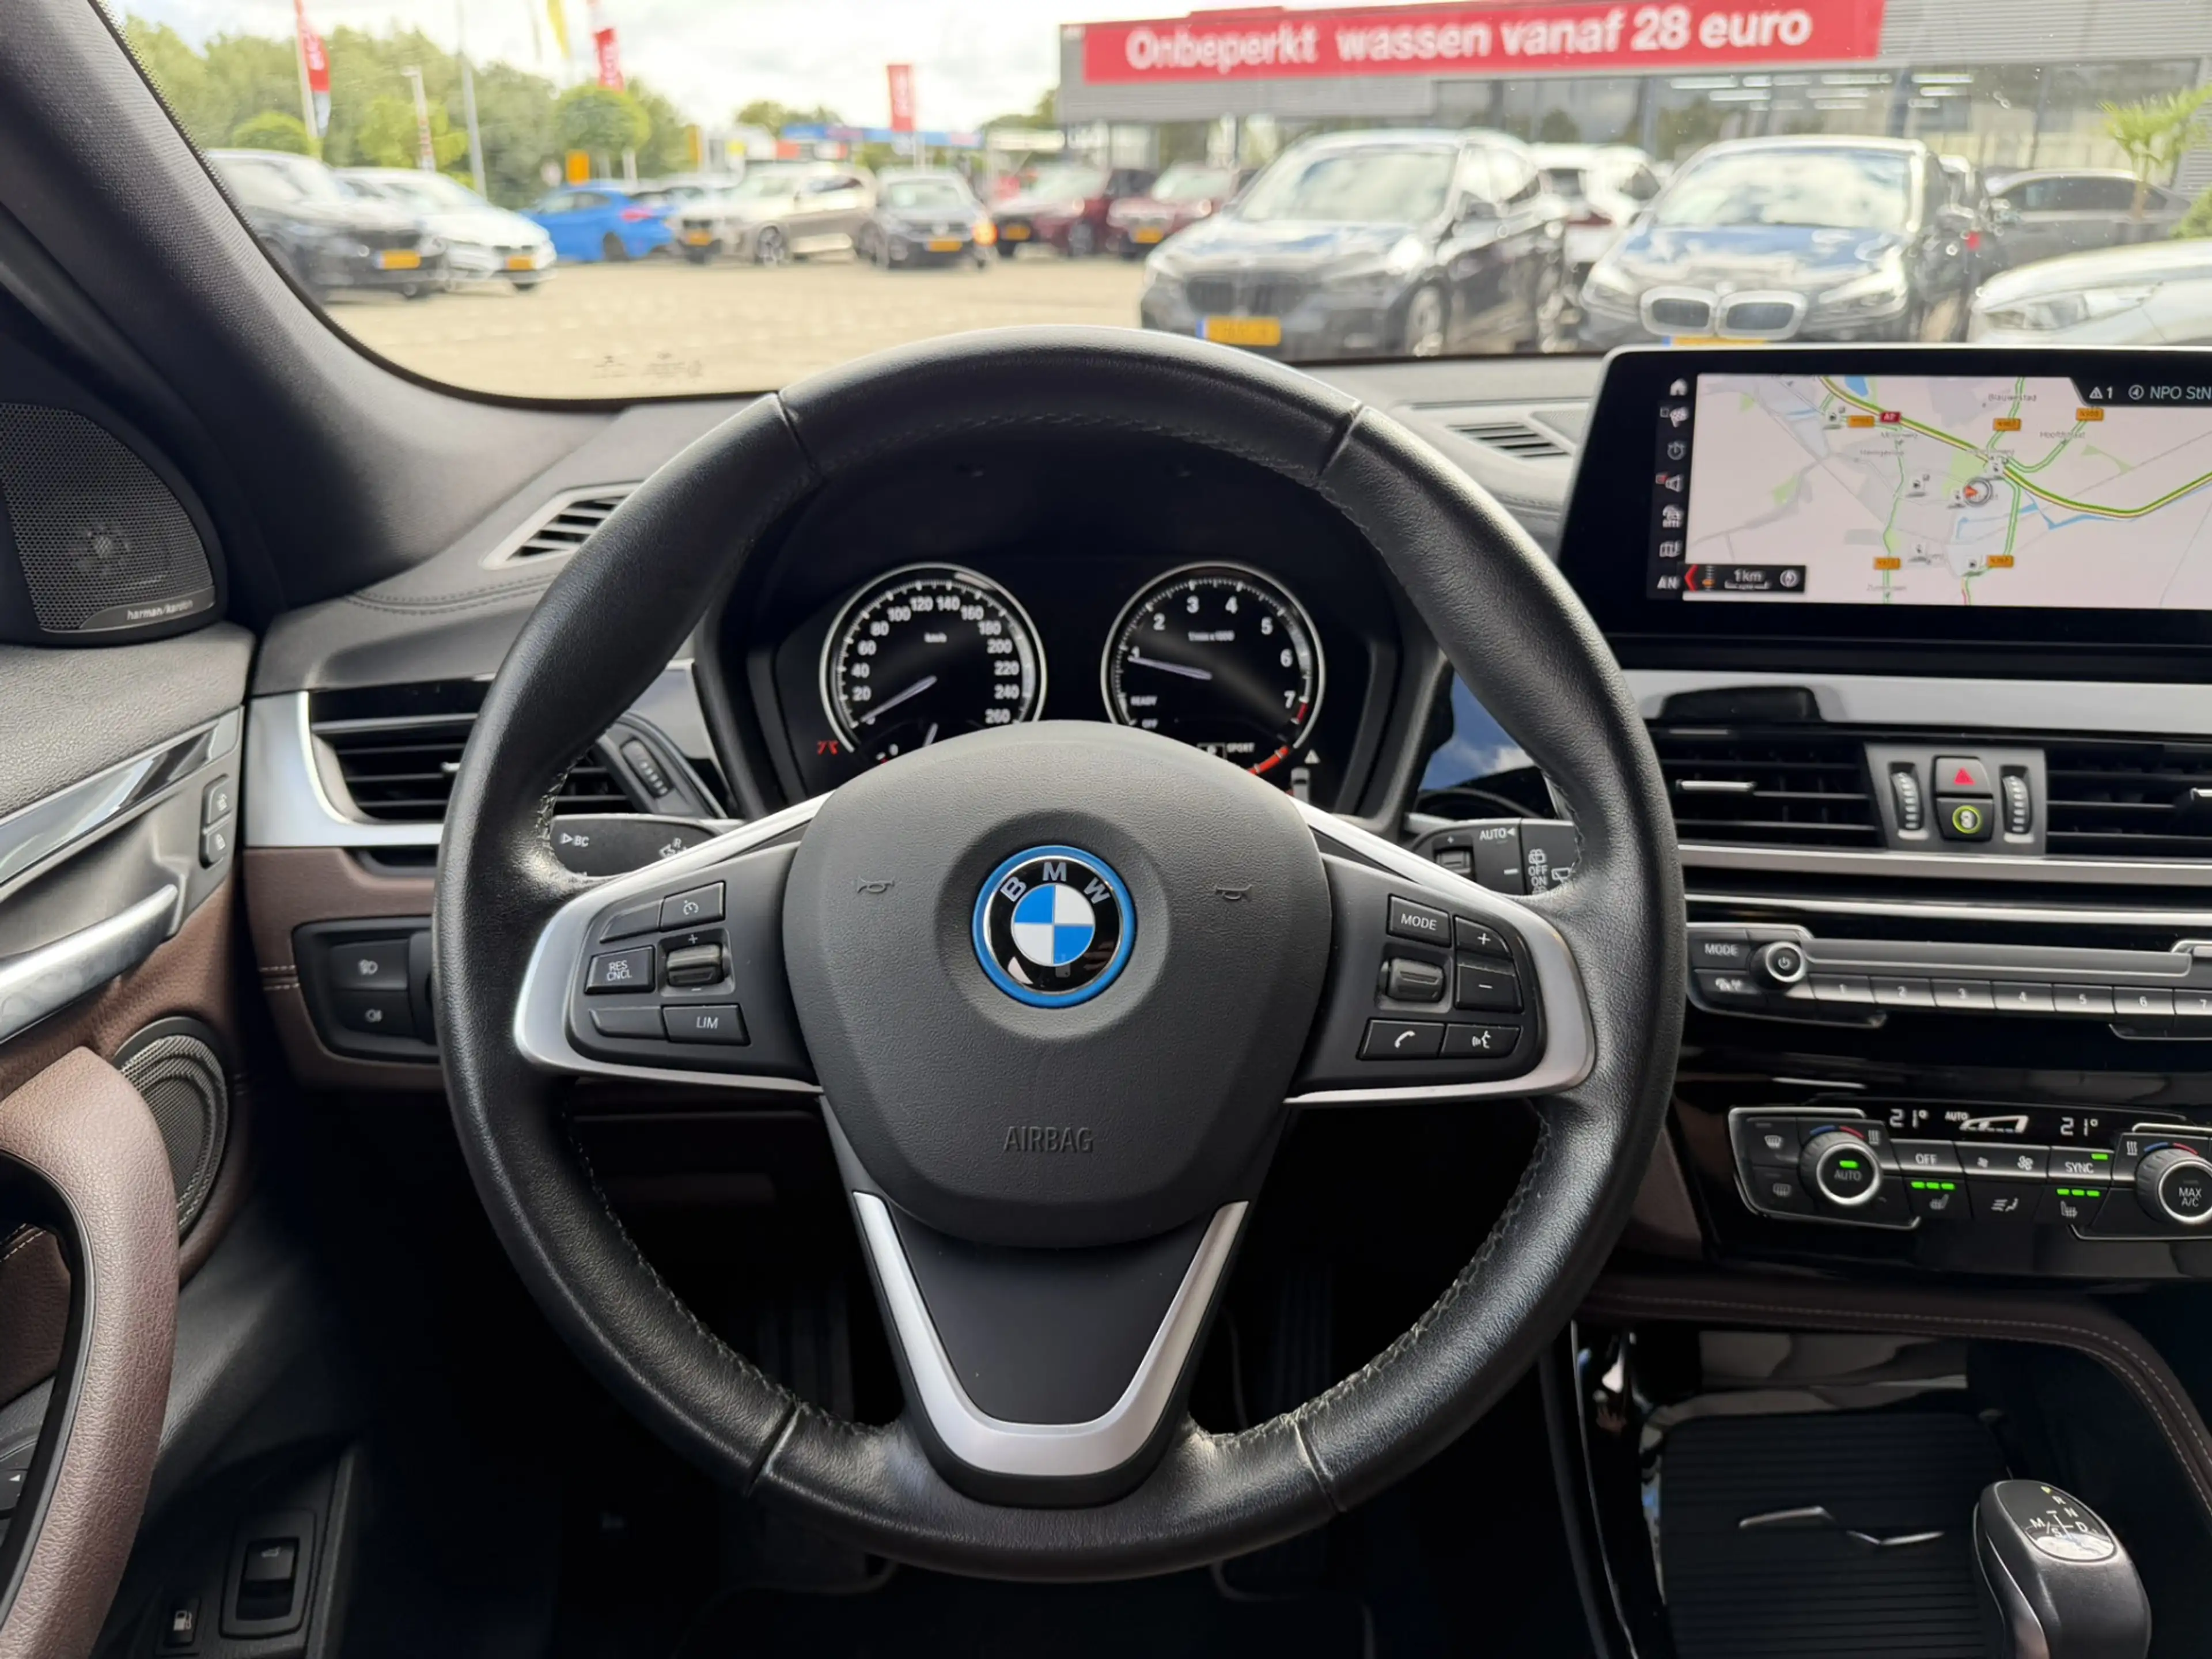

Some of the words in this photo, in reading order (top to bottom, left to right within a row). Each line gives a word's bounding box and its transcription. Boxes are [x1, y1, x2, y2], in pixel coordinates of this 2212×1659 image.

[1125, 22, 1319, 74] Onbeperkt
[1335, 22, 1491, 60] wassen
[1501, 10, 1626, 56] vanaf
[1631, 6, 1692, 51] 28
[1699, 9, 1812, 48] euro
[2107, 387, 2113, 399] 1
[2150, 386, 2182, 399] NPO
[1742, 570, 1762, 582] km
[910, 597, 933, 611] 120
[937, 596, 960, 611] 140
[1187, 596, 1199, 613] 3
[1225, 596, 1238, 613] 4
[888, 607, 911, 622] 100
[961, 606, 984, 620] 160
[979, 621, 1002, 635] 180
[1154, 613, 1165, 630] 2
[1262, 617, 1273, 634] 5
[870, 622, 889, 636] 80
[858, 641, 877, 656] 60
[987, 639, 1013, 654] 200
[1281, 649, 1293, 667] 6
[851, 663, 870, 678] 40
[994, 661, 1019, 675] 220
[853, 686, 872, 701] 20
[995, 685, 1020, 699] 240
[1284, 691, 1296, 709] 7
[986, 709, 1010, 724] 260
[574, 835, 589, 847] BC
[1479, 828, 1507, 840] AUTO
[1528, 865, 1548, 876] OFF
[1000, 862, 1111, 904] BMW
[1531, 877, 1548, 886] ON
[1401, 912, 1437, 931] MODE
[1705, 943, 1739, 956] MODE
[609, 960, 628, 971] RES
[607, 969, 632, 981] CNCL
[1839, 983, 1847, 995] 1
[1898, 986, 1907, 998] 2
[1959, 988, 1968, 999] 3
[2018, 991, 2028, 1002] 4
[2078, 994, 2087, 1005] 5
[2139, 996, 2147, 1007] 6
[2199, 999, 2208, 1010] 7
[696, 1017, 719, 1030] LIM
[1889, 1108, 1929, 1129] 21°
[1944, 1111, 1970, 1122] AUTO
[2060, 1116, 2099, 1137] 21°
[1003, 1126, 1094, 1153] AIRBAG
[1915, 1153, 1938, 1165] OFF
[2065, 1162, 2094, 1174] SYNC
[1834, 1171, 1862, 1181] AUTO
[2179, 1187, 2202, 1198] MAX
[2181, 1197, 2199, 1207] A/C
[2029, 1517, 2046, 1529] M
[2075, 1521, 2088, 1532] D
